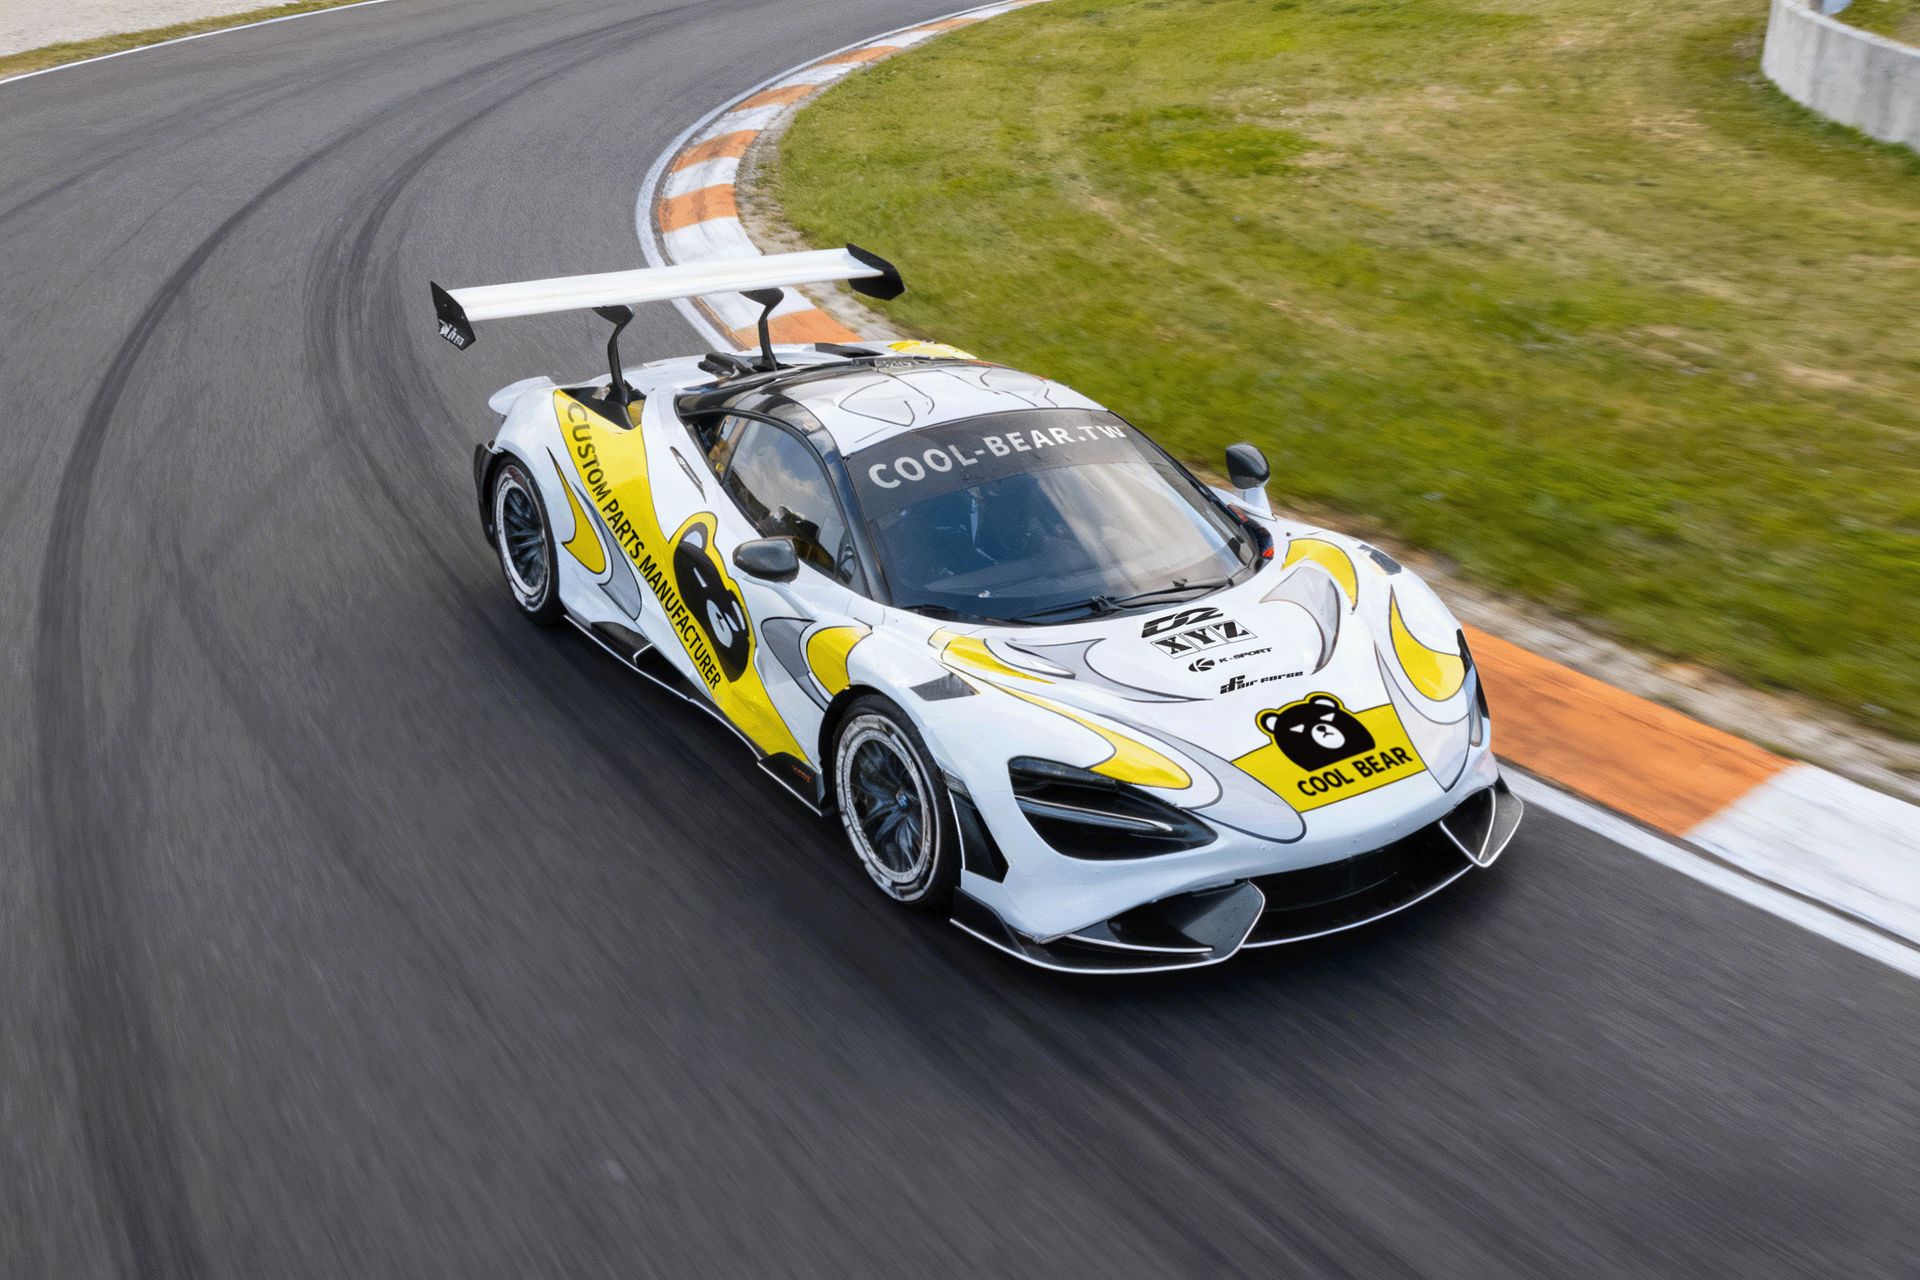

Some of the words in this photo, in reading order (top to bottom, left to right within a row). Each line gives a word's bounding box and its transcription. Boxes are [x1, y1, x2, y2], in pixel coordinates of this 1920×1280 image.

[868, 424, 1128, 489] COOL-BEAR.TW
[566, 402, 611, 503] CUSTOM
[602, 498, 645, 560] PARTS
[638, 554, 722, 691] MANUFACTURER
[1154, 621, 1250, 655] XYZ
[1218, 646, 1273, 663] K-SPORT
[1297, 768, 1355, 797] COOL
[1357, 746, 1414, 778] BEAR
